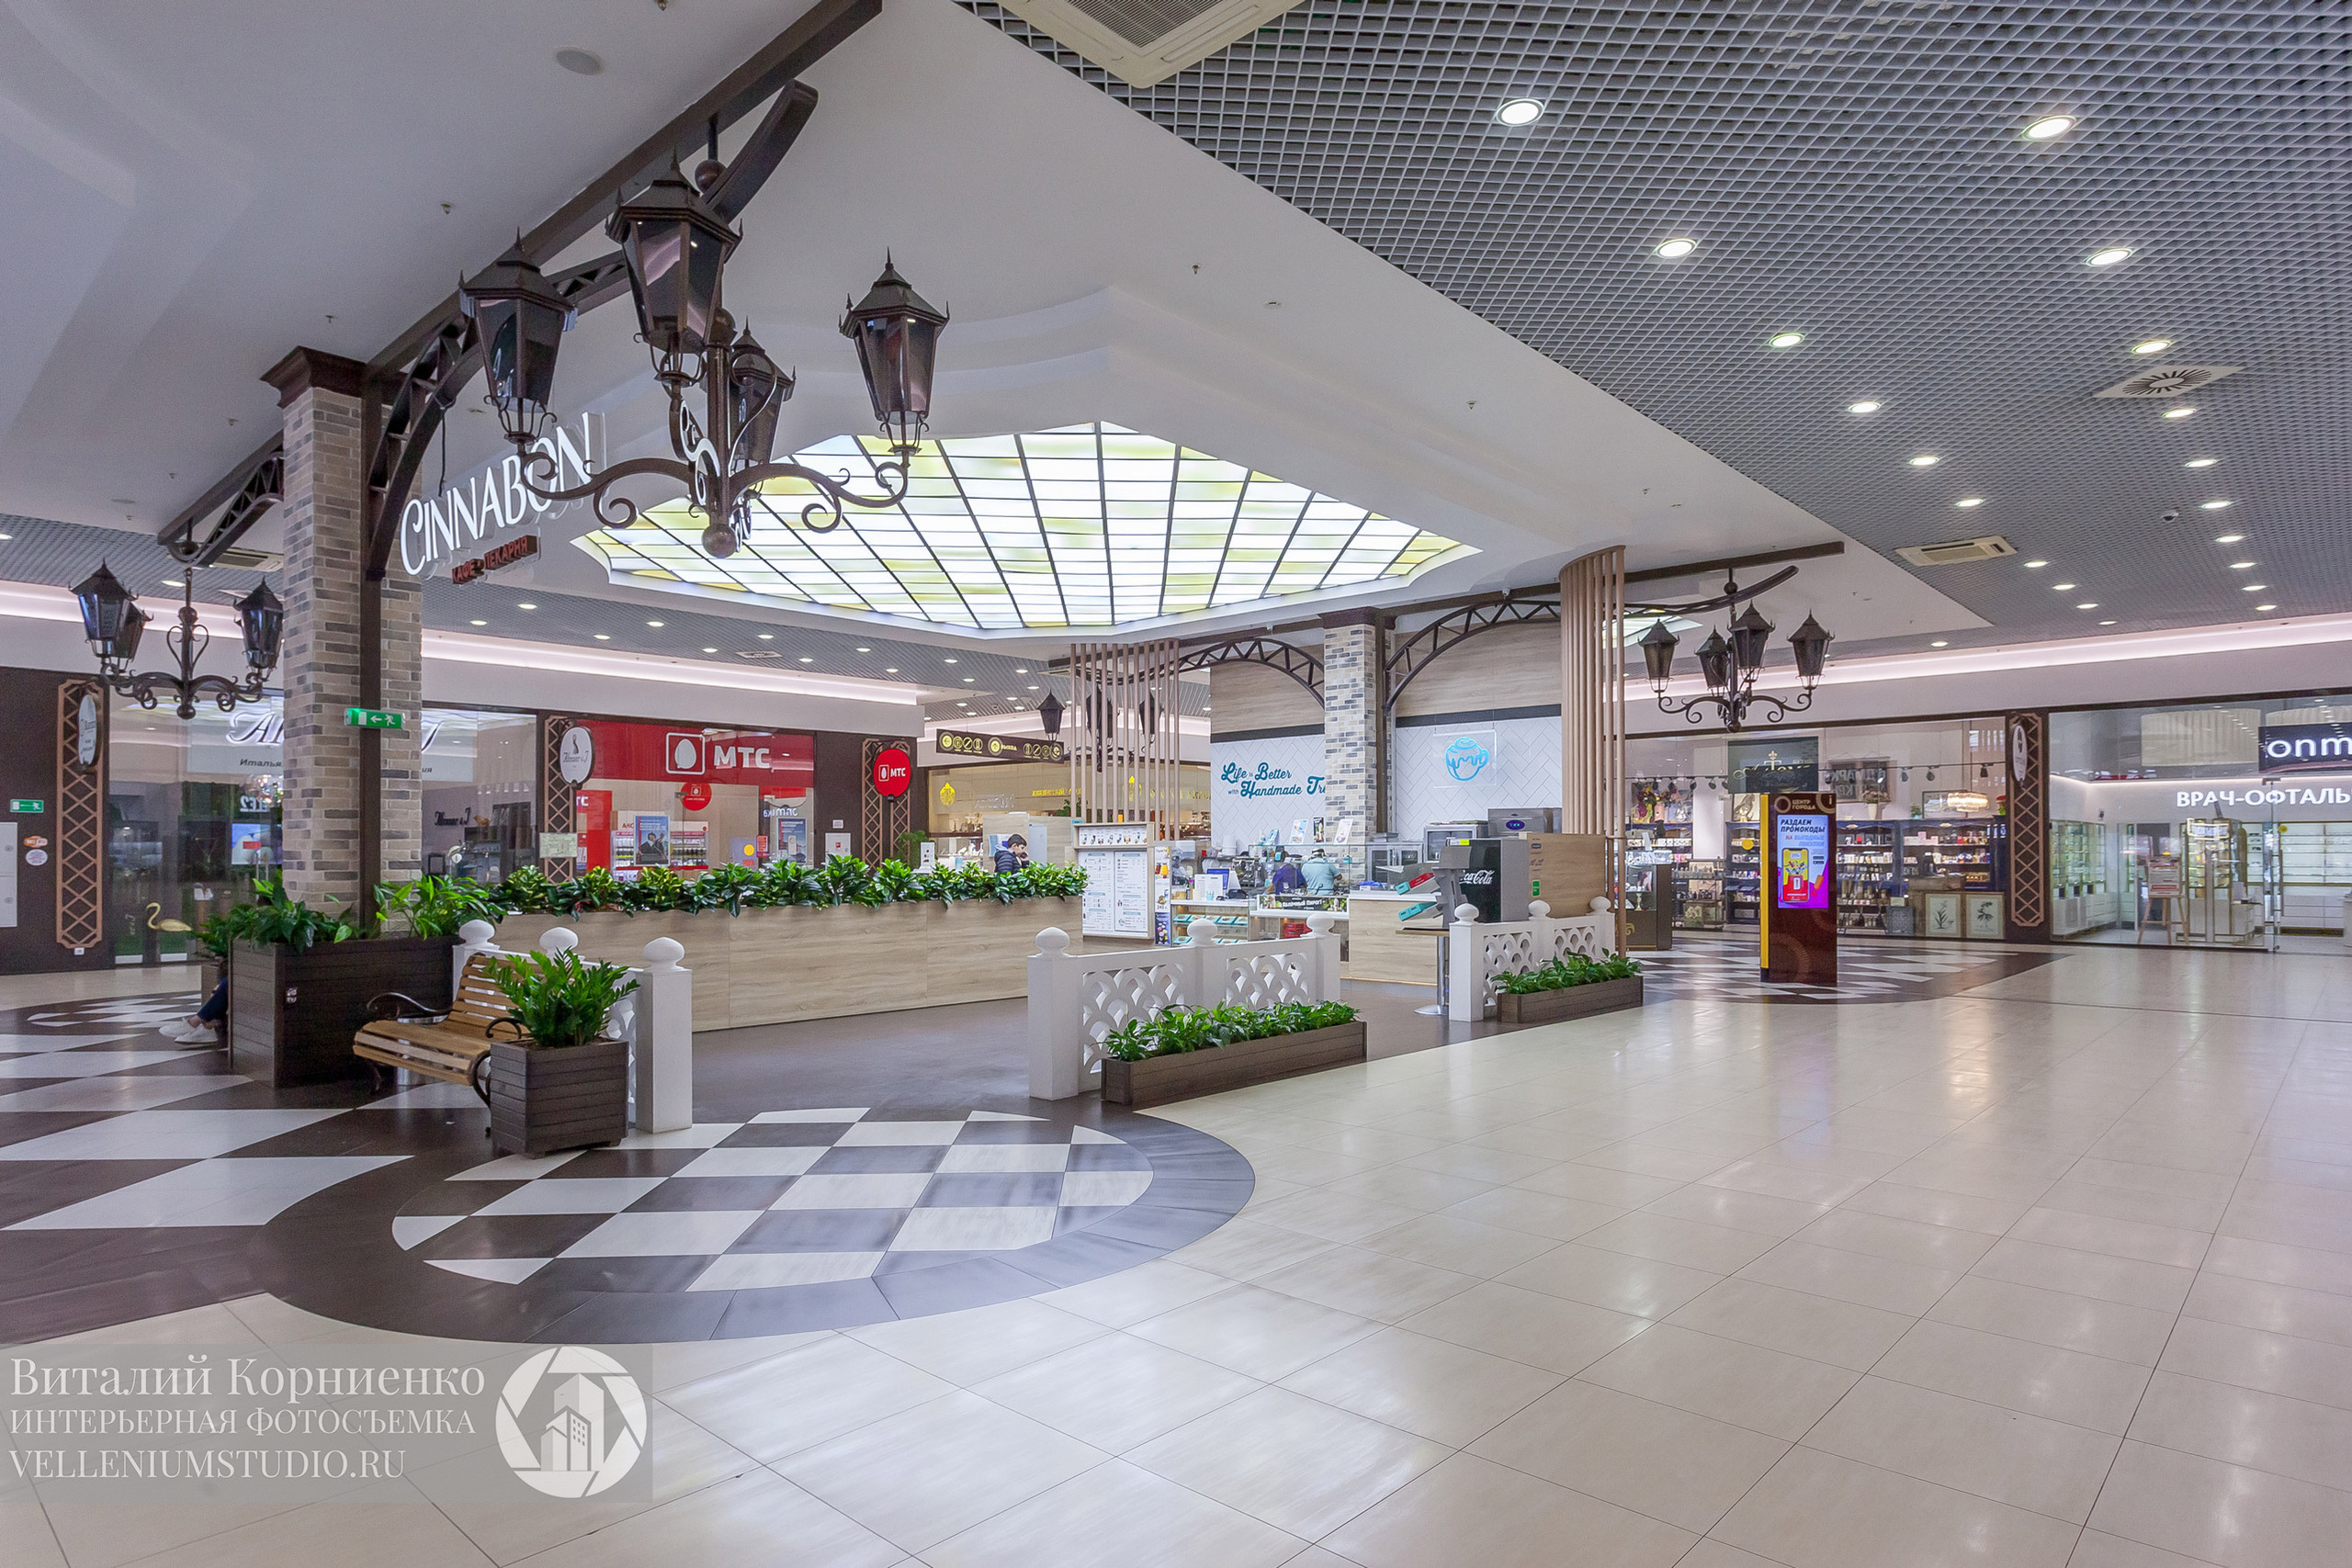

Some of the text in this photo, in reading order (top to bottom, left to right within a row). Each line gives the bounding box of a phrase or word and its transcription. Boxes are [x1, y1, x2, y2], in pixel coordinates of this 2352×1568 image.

[401, 412, 595, 576] CINNABON
[714, 746, 771, 770] МТС
[890, 768, 906, 777] МТС
[1221, 761, 1248, 784] Life
[1255, 761, 1292, 780] Better
[1240, 780, 1303, 799] Handmade
[2177, 787, 2352, 807] ВРАЧ-ОФТАЛЬ
